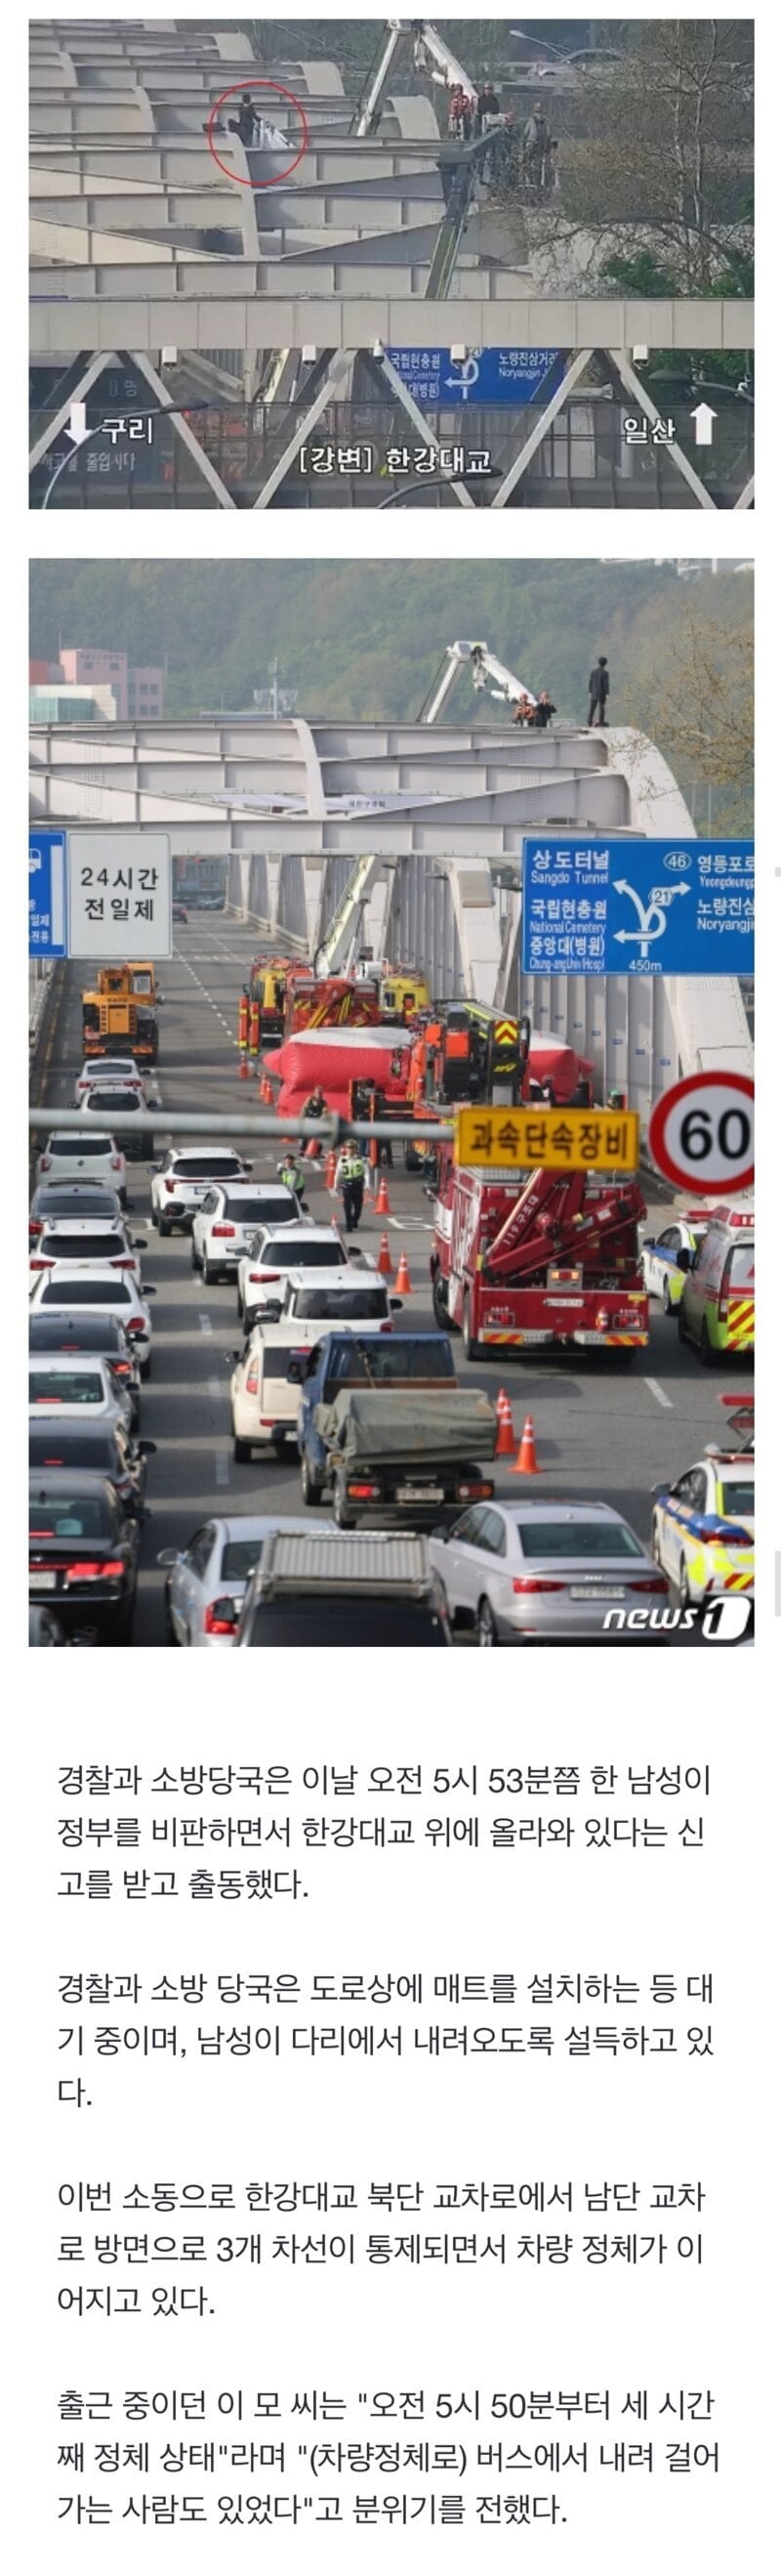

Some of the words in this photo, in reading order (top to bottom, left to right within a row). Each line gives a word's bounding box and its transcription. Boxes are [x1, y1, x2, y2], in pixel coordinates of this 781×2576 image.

[532, 850, 610, 870] 상도터널
[668, 856, 688, 868] 46
[81, 866, 159, 891] 24시간
[530, 871, 570, 886] Sangdo
[575, 871, 609, 884] Tunnel
[84, 897, 154, 921] 전일제
[530, 900, 607, 920] 국립현충원
[653, 890, 673, 905] 21
[529, 921, 564, 933] National
[565, 921, 606, 934] Cemetery
[529, 935, 605, 956] 중앙대(병원)
[628, 958, 663, 971] 450m
[471, 1119, 629, 1161] 과속단속장비
[680, 1108, 751, 1161] 60
[58, 1764, 143, 1795] 경찰과
[150, 1764, 293, 1796] 소방당국은
[303, 1764, 358, 1795] 이날
[367, 1764, 422, 1795] 오전
[432, 1764, 477, 1795] 5시
[488, 1765, 581, 1795] 53분쯤
[590, 1764, 619, 1795] 한
[628, 1764, 710, 1795] 남성이
[58, 1817, 142, 1848] 정부를
[152, 1817, 290, 1848] 비판하면서
[302, 1817, 415, 1848] 한강대교
[424, 1817, 478, 1848] 위에
[489, 1817, 576, 1848] 올라와
[584, 1817, 669, 1848] 있다는
[678, 1817, 704, 1847] 신
[57, 1870, 113, 1899] 고를
[123, 1869, 179, 1899] 받고
[187, 1869, 308, 1900] 출동했다.
[58, 1973, 143, 2005] 경찰과
[150, 1973, 208, 2004] 소방
[218, 1973, 301, 2005] 당국은
[310, 1973, 423, 2005] 도로상에
[433, 1973, 517, 2005] 매트를
[527, 1973, 640, 2005] 설치하는
[649, 1974, 678, 2004] 등
[686, 1973, 713, 2005] 대
[58, 2025, 83, 2056] 기
[94, 2025, 186, 2058] 중이며,
[197, 2025, 279, 2056] 남성이
[292, 2025, 402, 2056] 다리에서
[414, 2025, 555, 2056] 내려오도록
[564, 2025, 678, 2056] 설득하고
[686, 2025, 714, 2056] 있
[58, 2077, 92, 2108] 다.
[58, 2181, 111, 2213] 이번
[122, 2182, 236, 2213] 소동으로
[245, 2181, 358, 2213] 한강대교
[367, 2181, 425, 2213] 북단
[432, 2181, 572, 2213] 교차로에서
[585, 2181, 641, 2212] 남단
[649, 2181, 707, 2213] 교차
[57, 2236, 85, 2260] 로
[95, 2233, 208, 2264] 방면으로
[217, 2233, 261, 2264] 3개
[271, 2233, 354, 2264] 차선이
[365, 2233, 506, 2264] 통제되면서
[516, 2233, 573, 2264] 차량
[582, 2233, 668, 2264] 정체가
[678, 2233, 702, 2264] 이
[58, 2286, 142, 2317] 어지고
[151, 2285, 215, 2317] 있다.
[57, 2389, 113, 2421] 출근
[122, 2389, 206, 2421] 중이던
[218, 2389, 242, 2421] 이
[254, 2392, 282, 2417] 모
[290, 2389, 348, 2421] 씨는
[358, 2389, 425, 2420] "오전
[435, 2389, 479, 2421] 5시
[490, 2389, 609, 2421] 50분부터
[621, 2389, 647, 2421] 세
[658, 2389, 716, 2421] 시간
[57, 2442, 84, 2473] 째
[94, 2442, 149, 2473] 정체
[159, 2442, 285, 2473] 상태"라며
[298, 2442, 468, 2477] "(차량정체로)
[477, 2441, 587, 2473] 버스에서
[599, 2441, 653, 2473] 내려
[665, 2442, 719, 2473] 걸어
[58, 2494, 113, 2525] 가는
[121, 2494, 208, 2525] 사람도
[217, 2494, 344, 2525] 있었다"고
[352, 2494, 466, 2525] 분위기를
[475, 2494, 567, 2525] 전했다.
